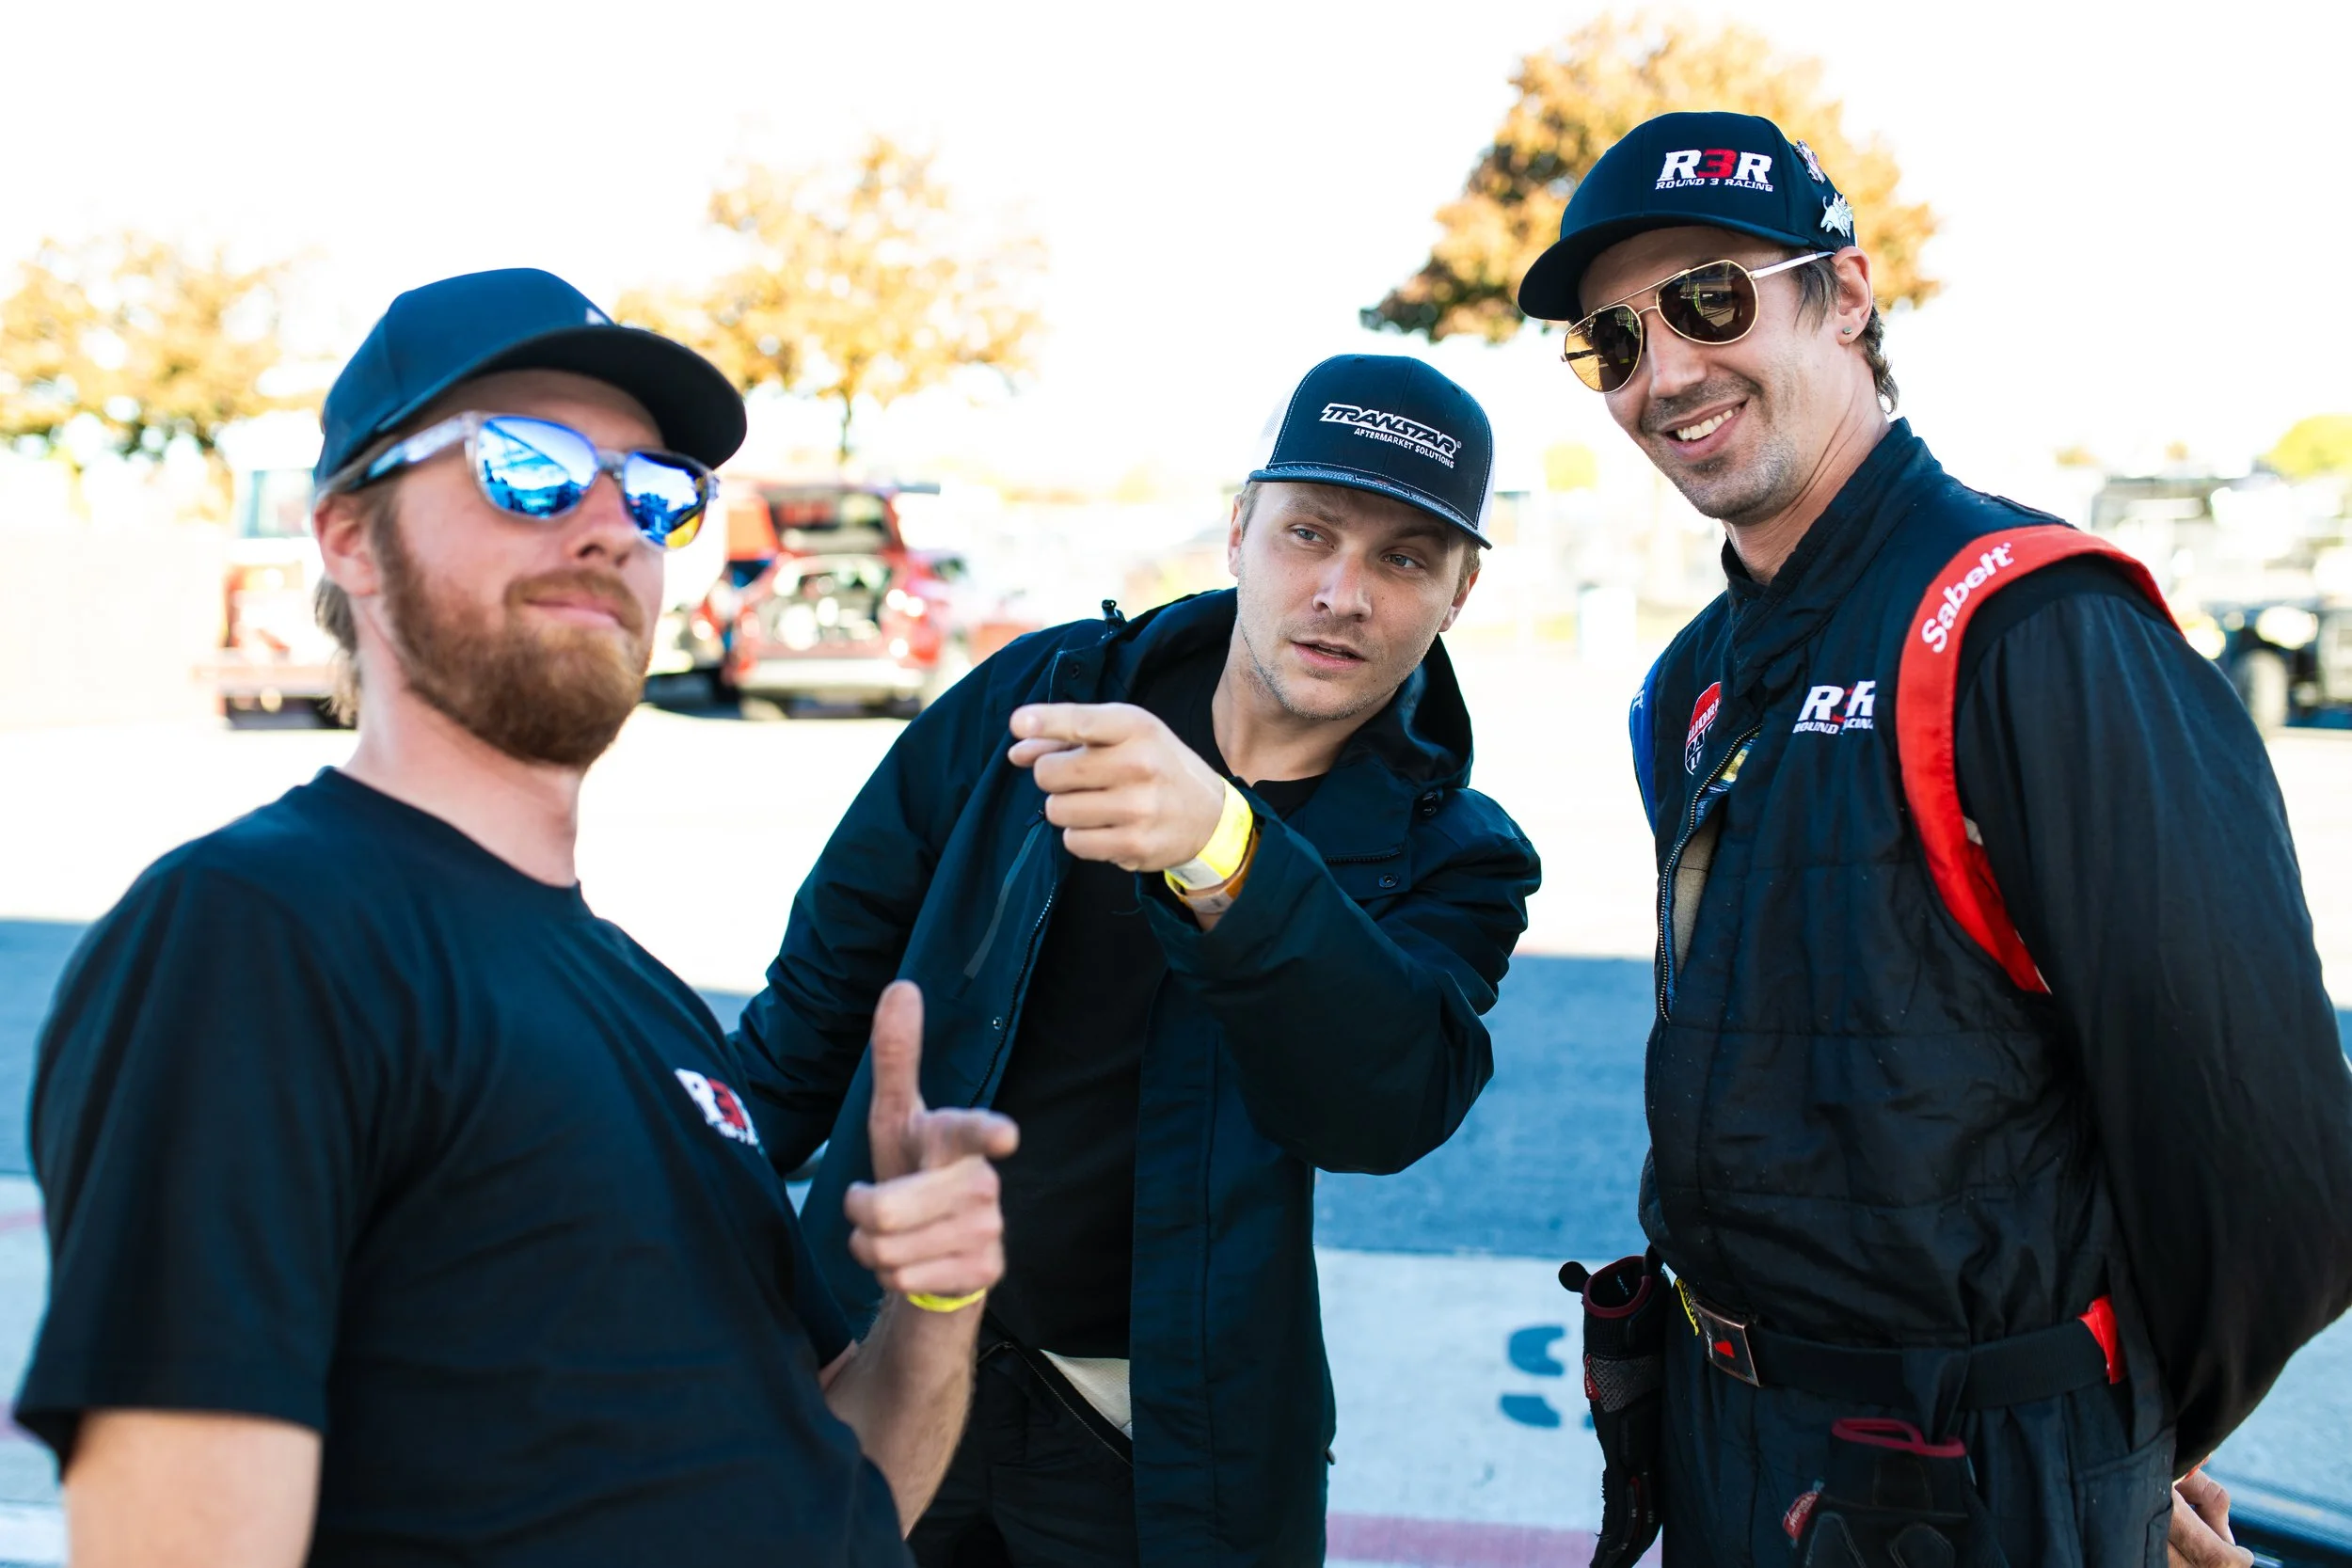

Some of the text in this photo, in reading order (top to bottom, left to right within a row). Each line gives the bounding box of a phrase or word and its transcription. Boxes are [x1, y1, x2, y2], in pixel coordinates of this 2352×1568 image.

[1655, 177, 1773, 192] ROUND 3 RACING
[1656, 148, 1773, 183] R3R
[1319, 403, 1457, 459] TRANSTAR
[1353, 427, 1454, 469] AFTERMARKET SOLUTIONS
[1921, 545, 2014, 653] Sabelt
